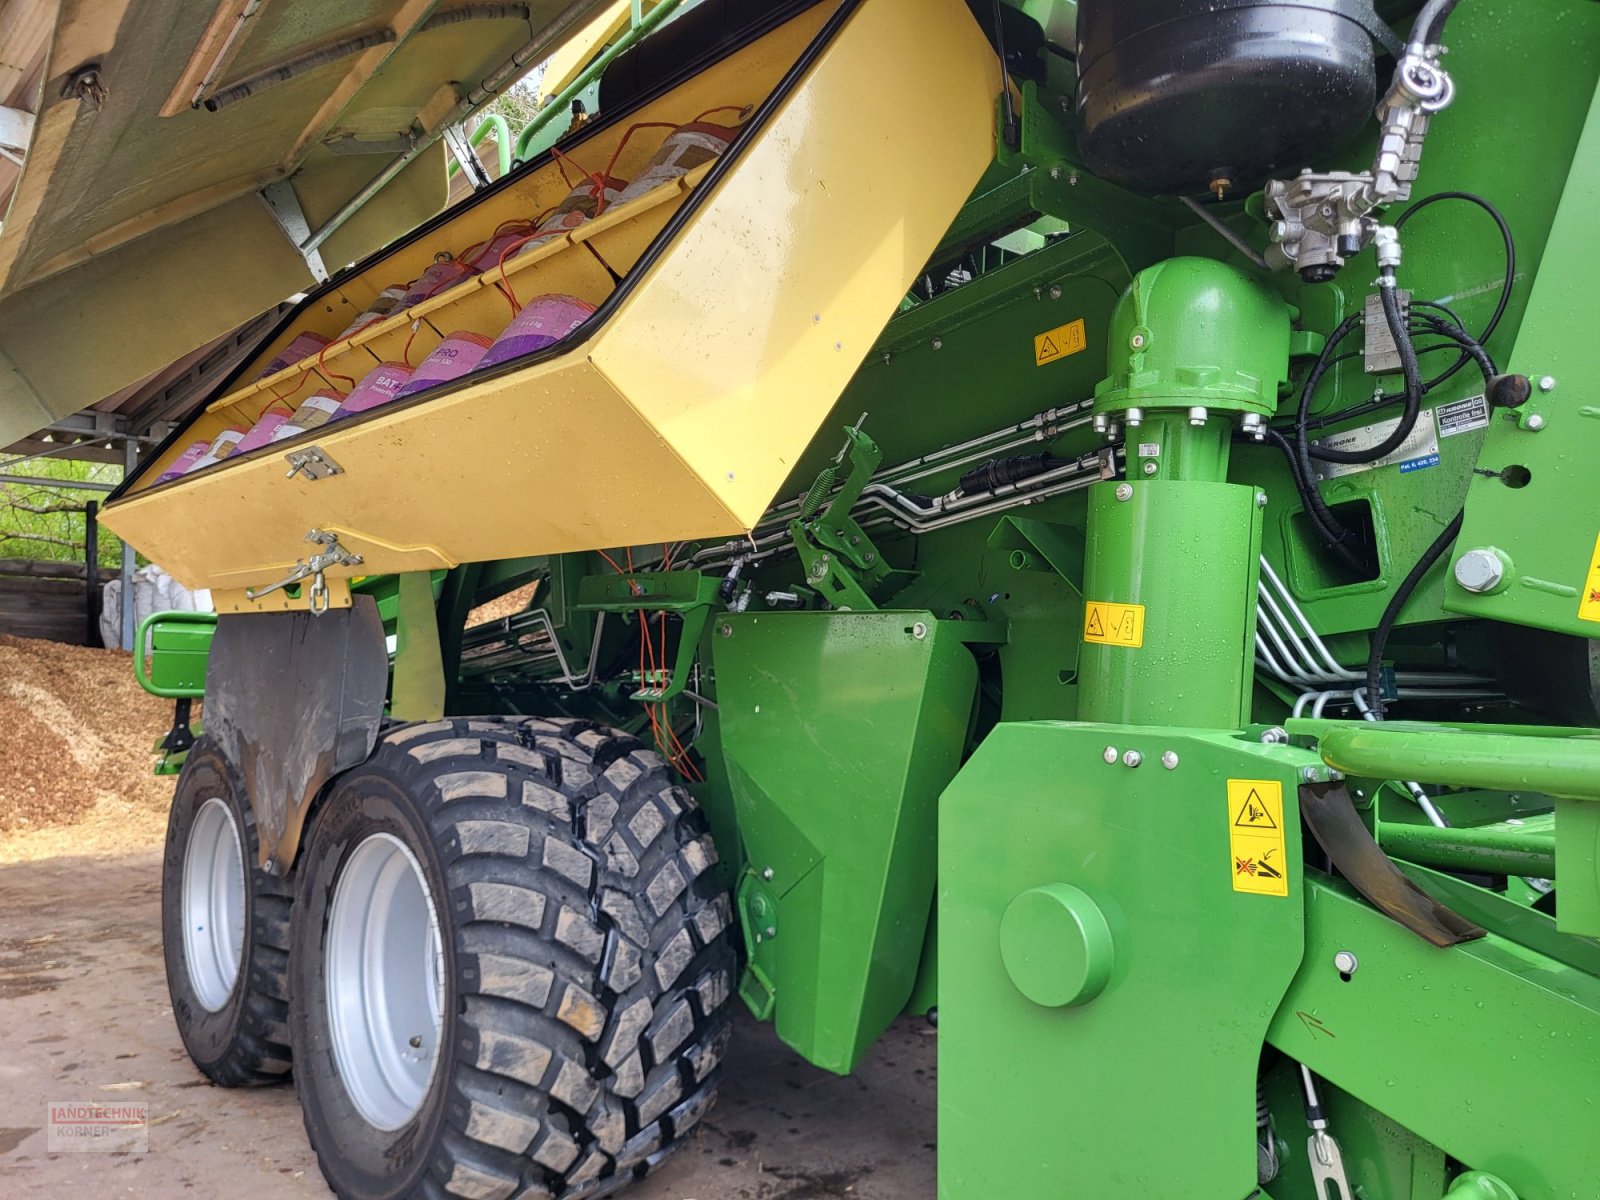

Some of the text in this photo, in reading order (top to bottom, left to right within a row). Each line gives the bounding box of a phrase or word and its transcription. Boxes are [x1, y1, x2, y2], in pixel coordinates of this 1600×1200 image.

[1441, 412, 1471, 425] Kontrolle
[1471, 408, 1483, 417] frei
[1327, 436, 1357, 448] KRONE
